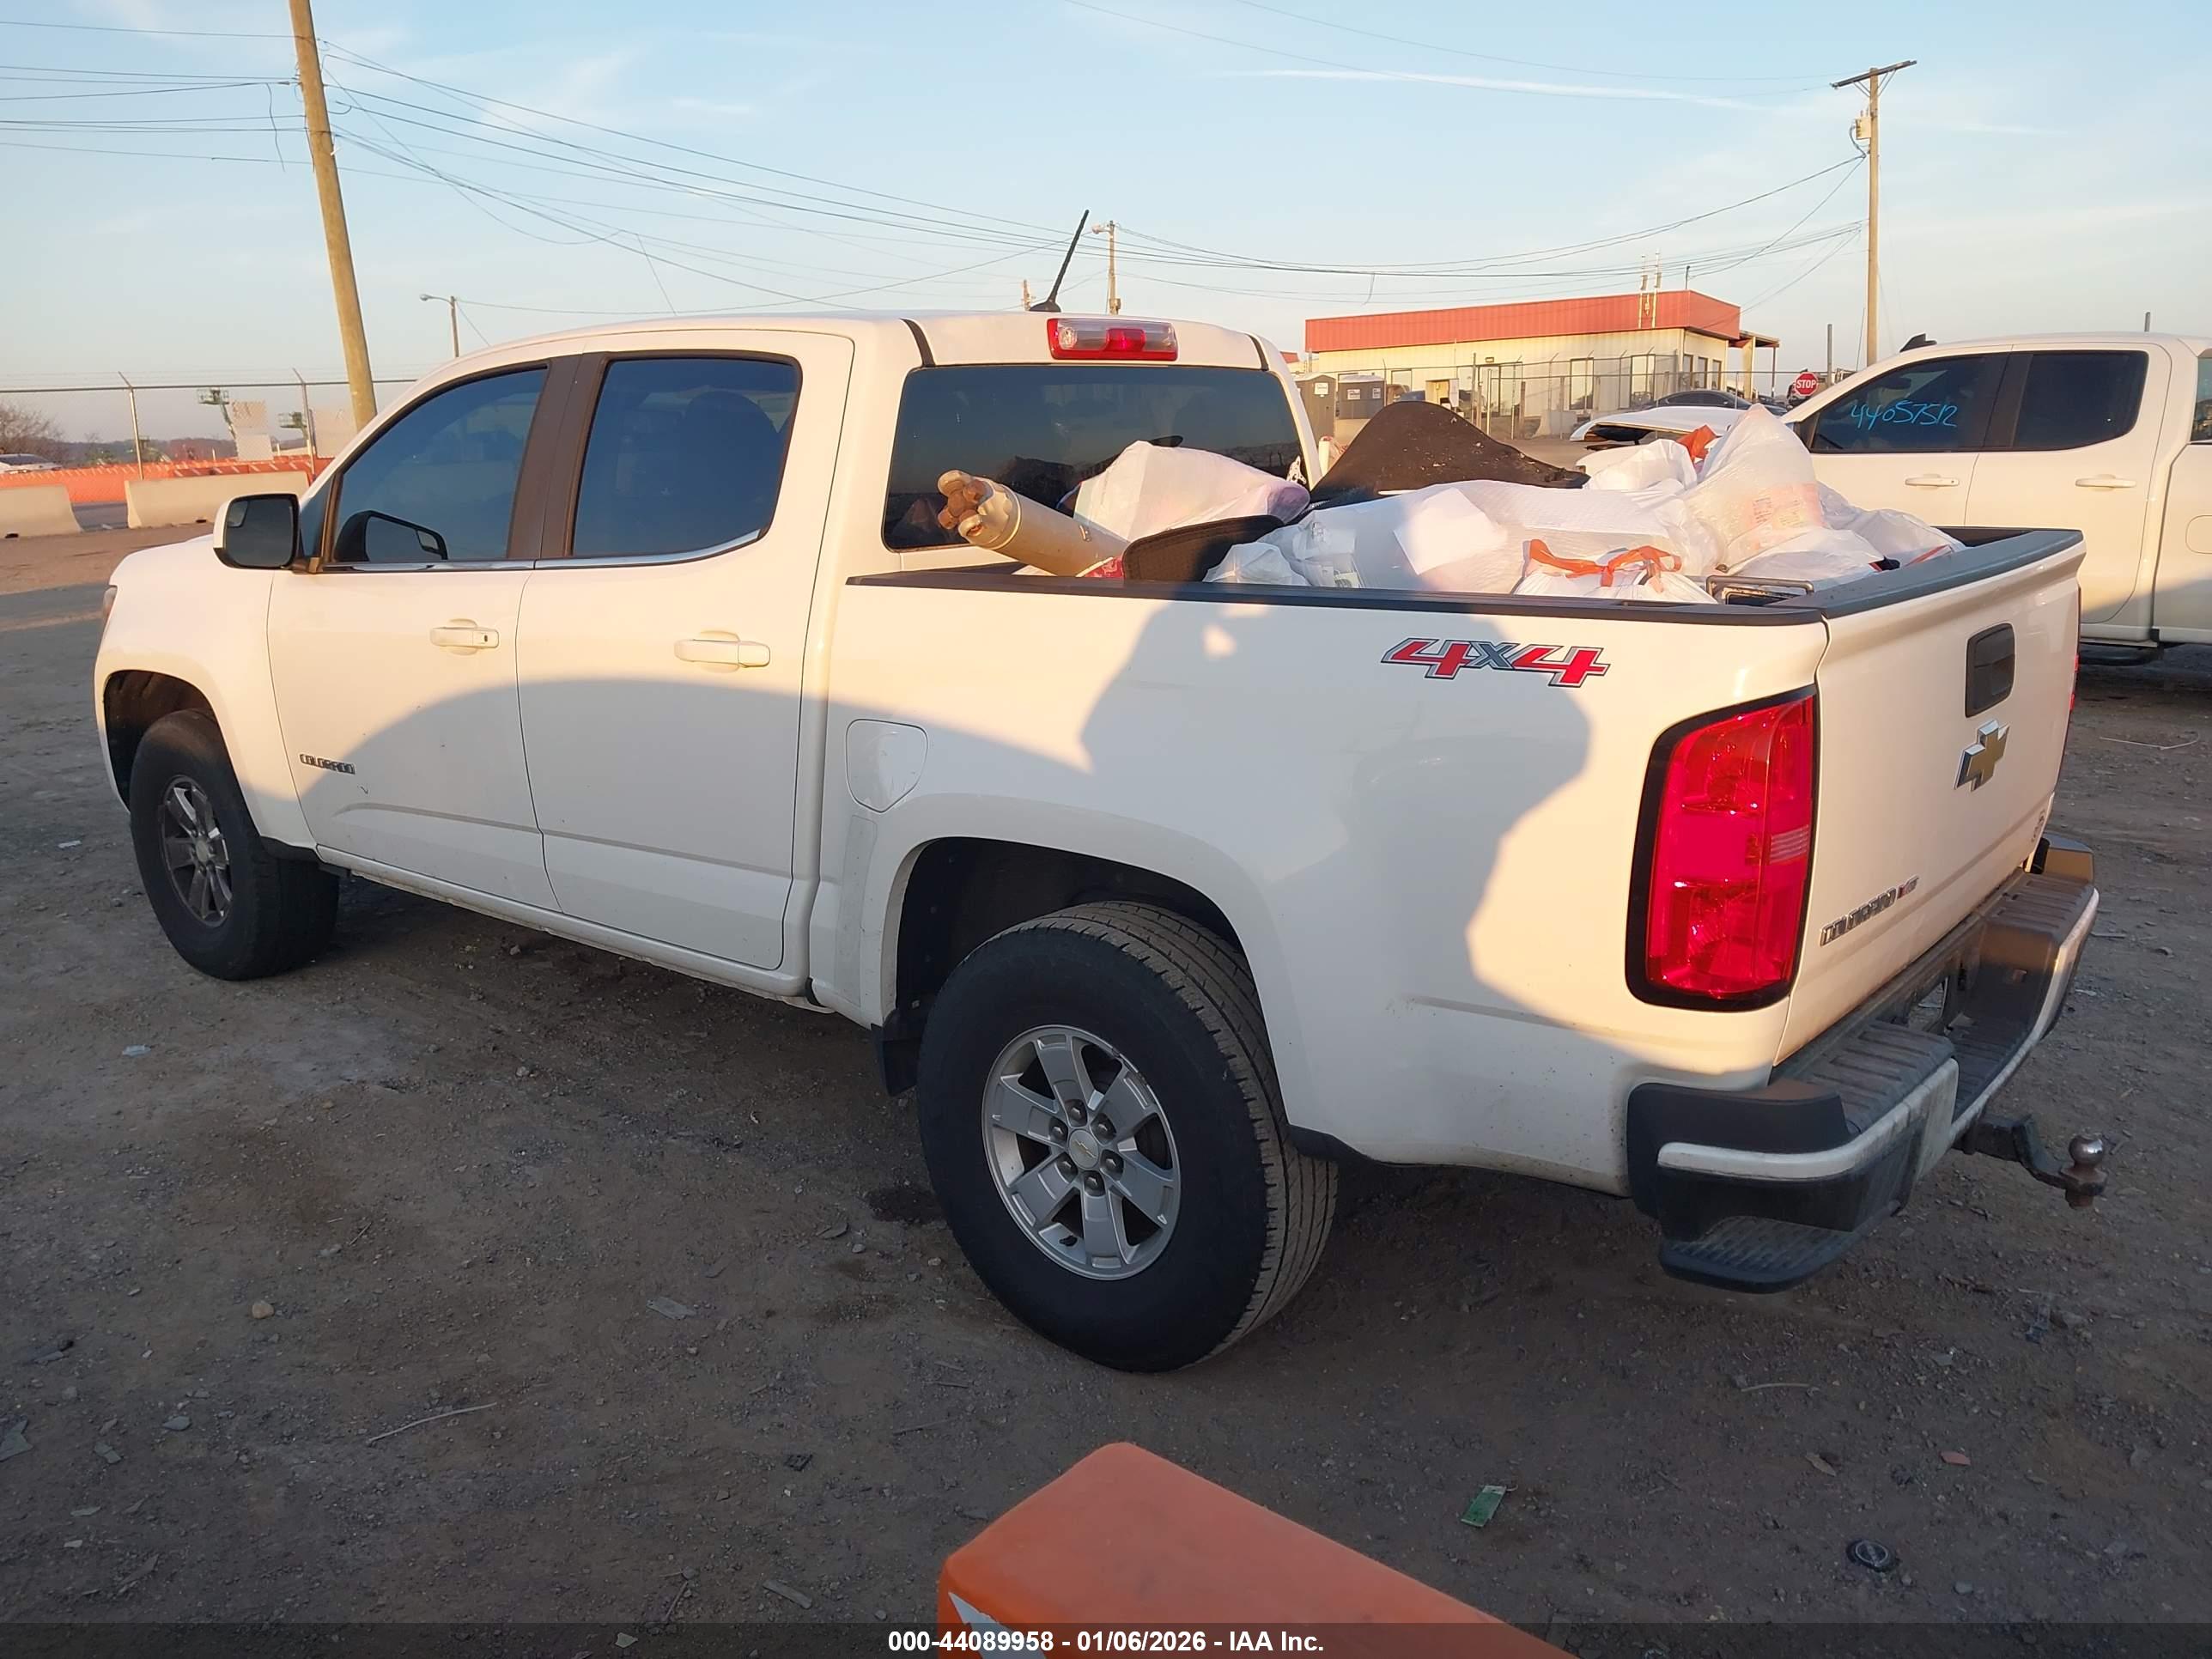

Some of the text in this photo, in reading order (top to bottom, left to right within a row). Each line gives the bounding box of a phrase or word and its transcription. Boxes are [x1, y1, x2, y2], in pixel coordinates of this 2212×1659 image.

[1796, 380, 1816, 388] STOP
[1851, 400, 1958, 429] 44057512
[299, 753, 356, 775] COLORADO
